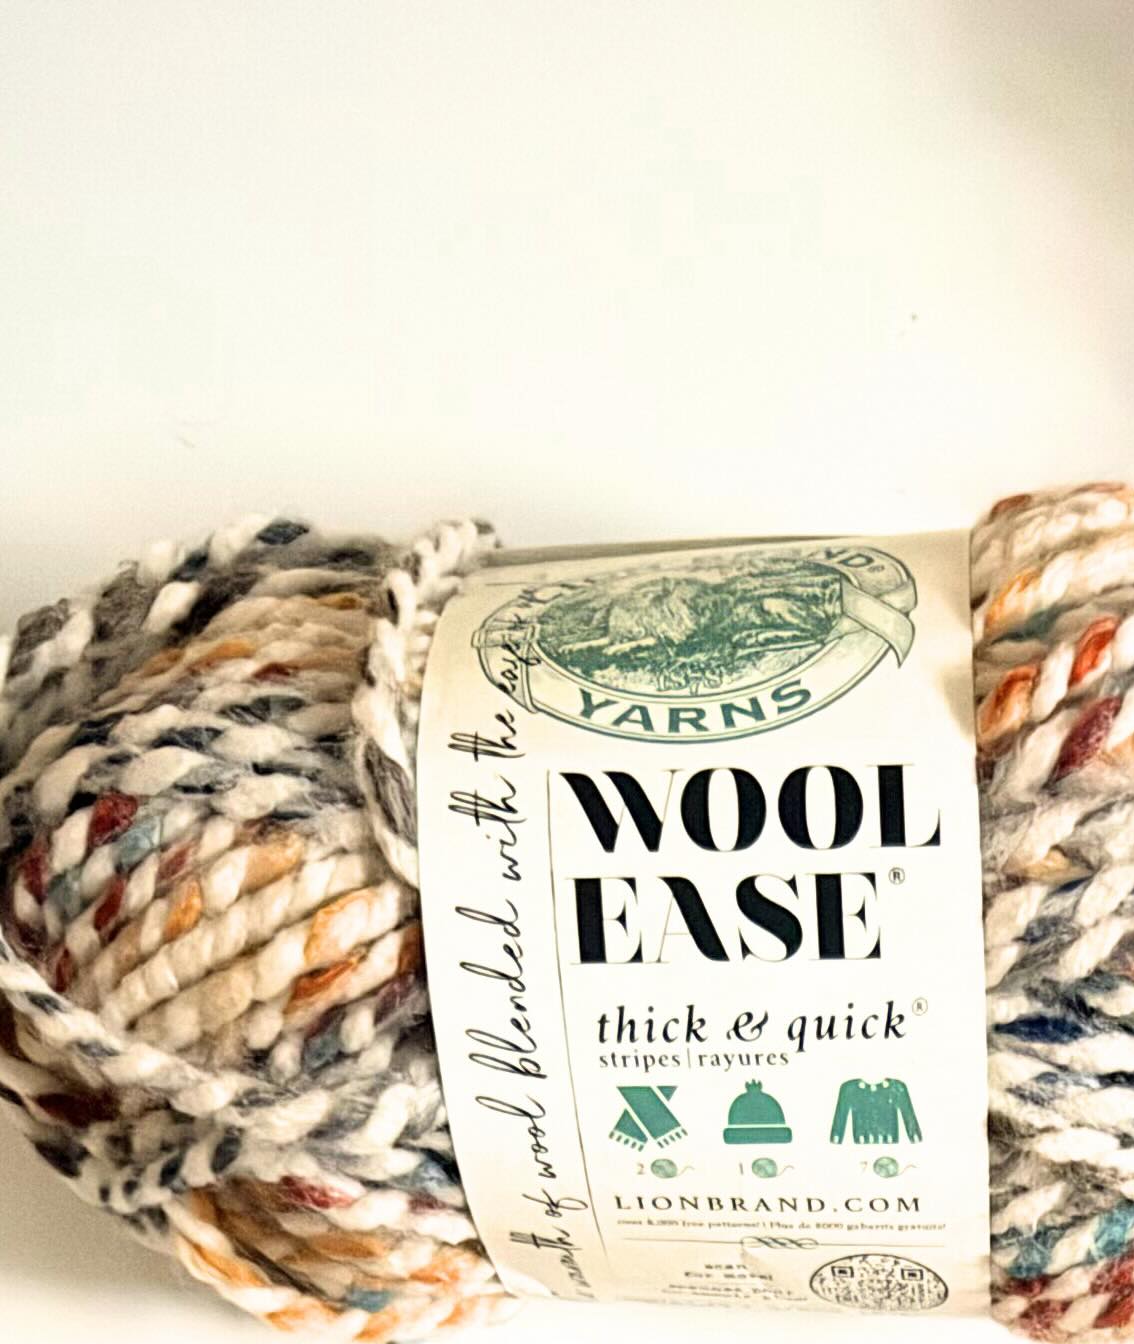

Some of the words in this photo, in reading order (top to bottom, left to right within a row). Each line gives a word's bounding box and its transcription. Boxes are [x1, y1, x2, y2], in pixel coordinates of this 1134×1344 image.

[579, 679, 811, 733] YARNS
[448, 709, 526, 762] the
[448, 775, 527, 881] with
[558, 763, 941, 853] WOOL
[455, 898, 547, 1079] blended
[597, 1004, 709, 1044] thick
[726, 1010, 769, 1042] &
[599, 1049, 681, 1073] stripes
[698, 1051, 790, 1072] rayures
[475, 1095, 556, 1178] wool
[522, 1188, 588, 1217] of
[614, 1194, 921, 1213] LIONBRAND.COM
